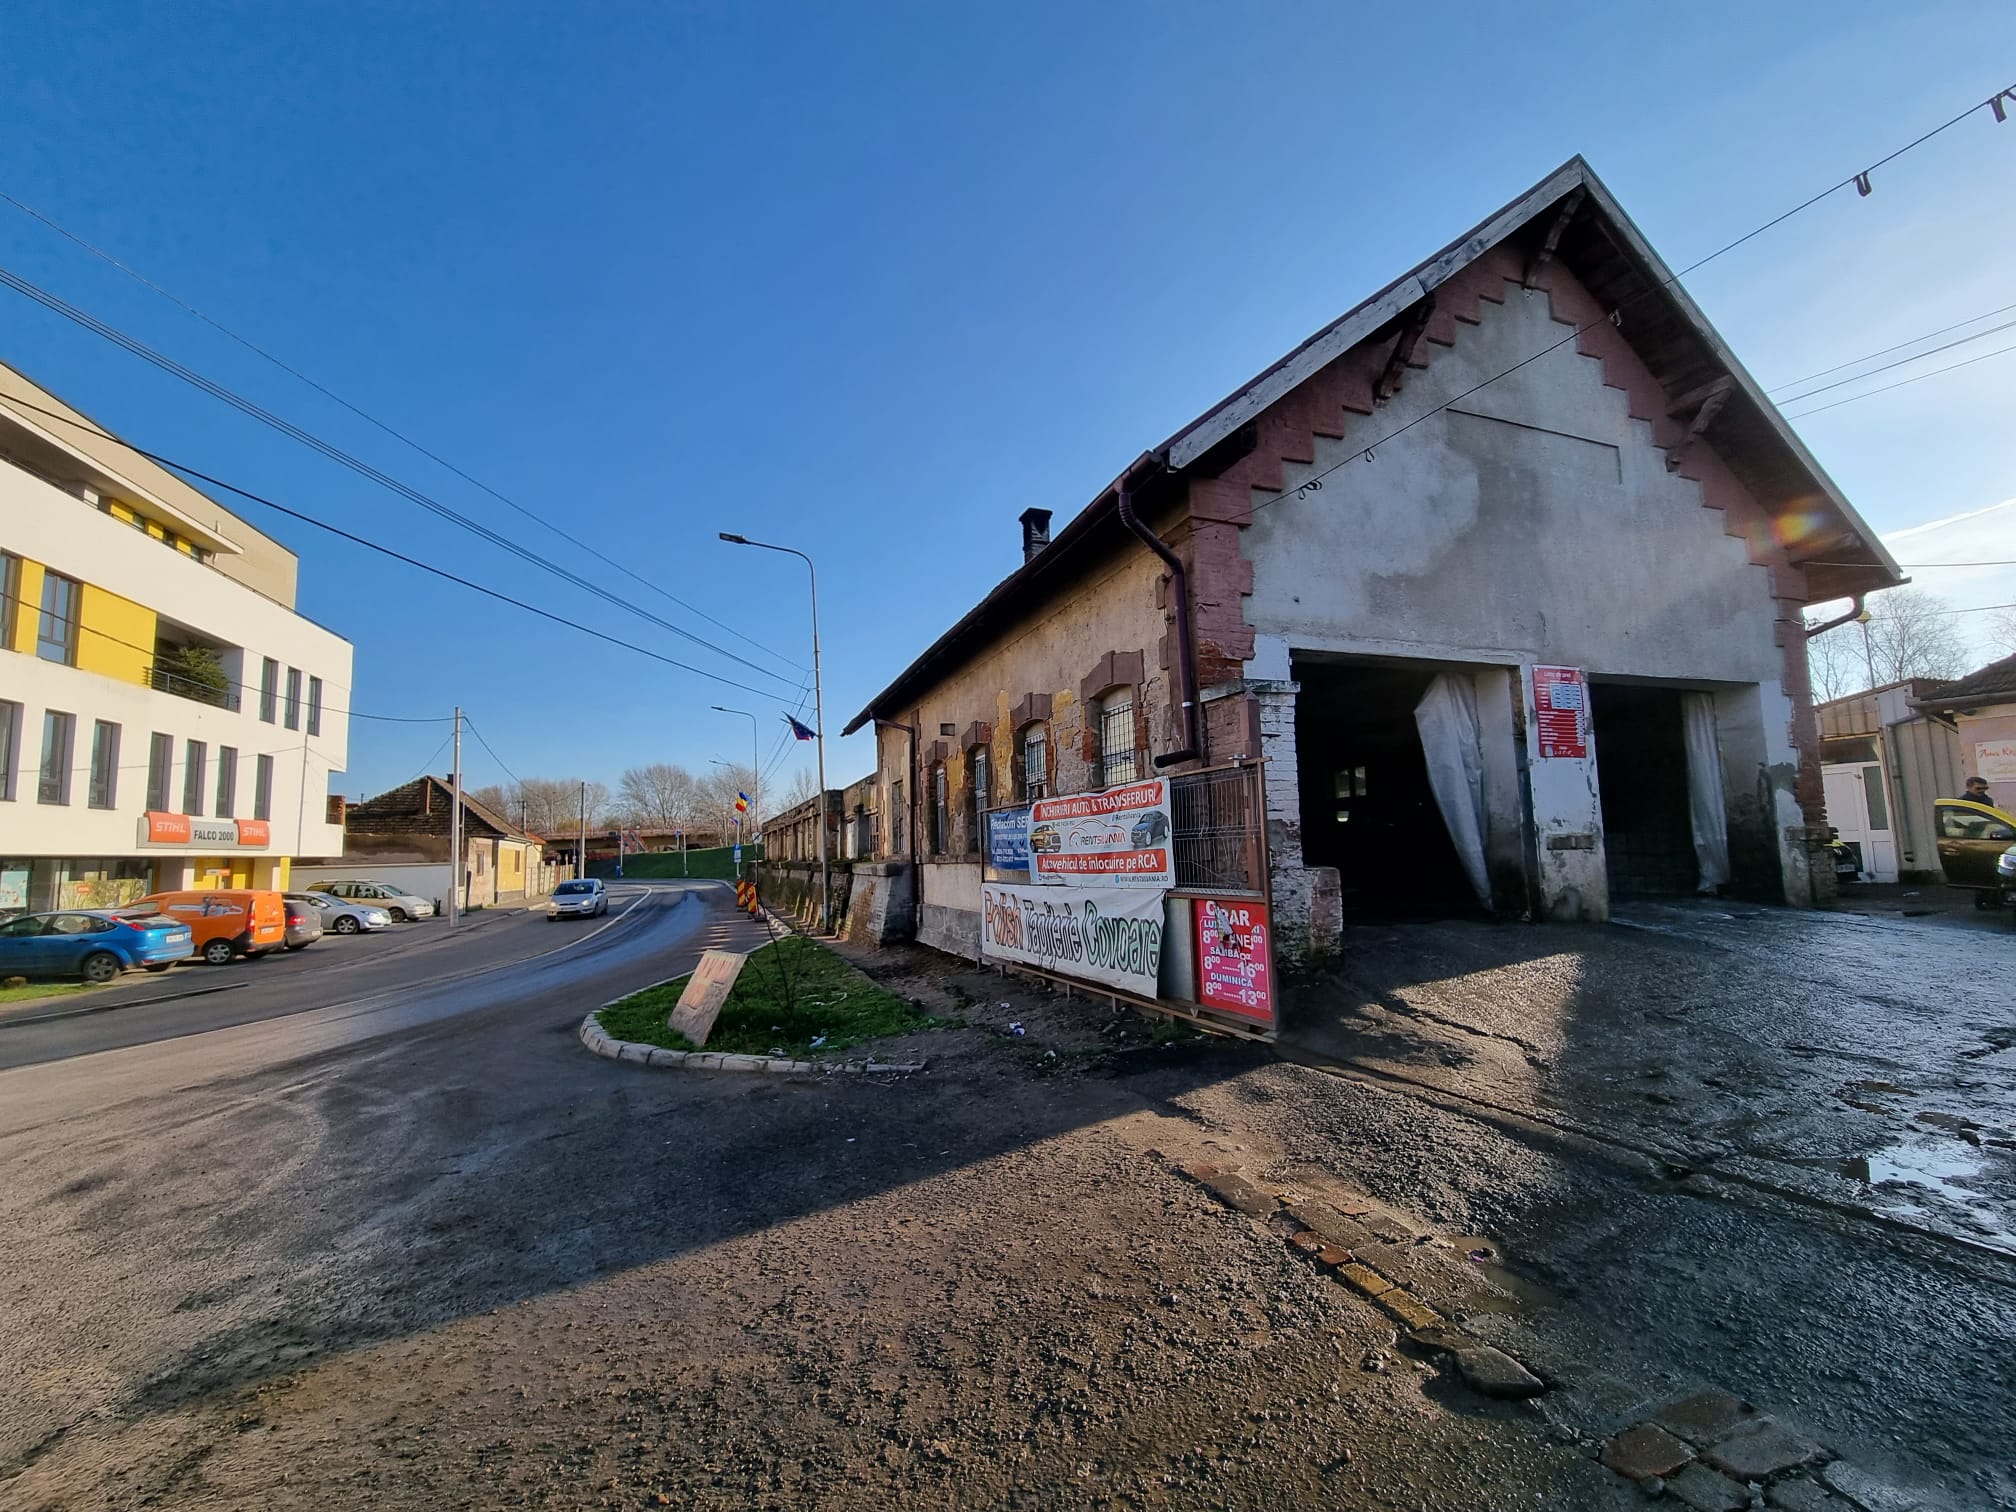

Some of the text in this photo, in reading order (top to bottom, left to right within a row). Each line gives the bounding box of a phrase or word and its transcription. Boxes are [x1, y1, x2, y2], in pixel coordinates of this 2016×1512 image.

[1072, 801, 1090, 815] AUTO
[1092, 799, 1098, 812] &
[1098, 787, 1156, 810] TRANSFERURI
[155, 822, 187, 833] STIHL
[194, 829, 234, 841] FALCO 2000
[243, 826, 265, 837] STIHL
[1078, 858, 1087, 870] de
[1088, 855, 1124, 870] înlocuire
[1126, 857, 1136, 872] pe
[1137, 853, 1158, 868] RCA
[984, 891, 1024, 950] Polish
[1082, 900, 1162, 978] Covoare
